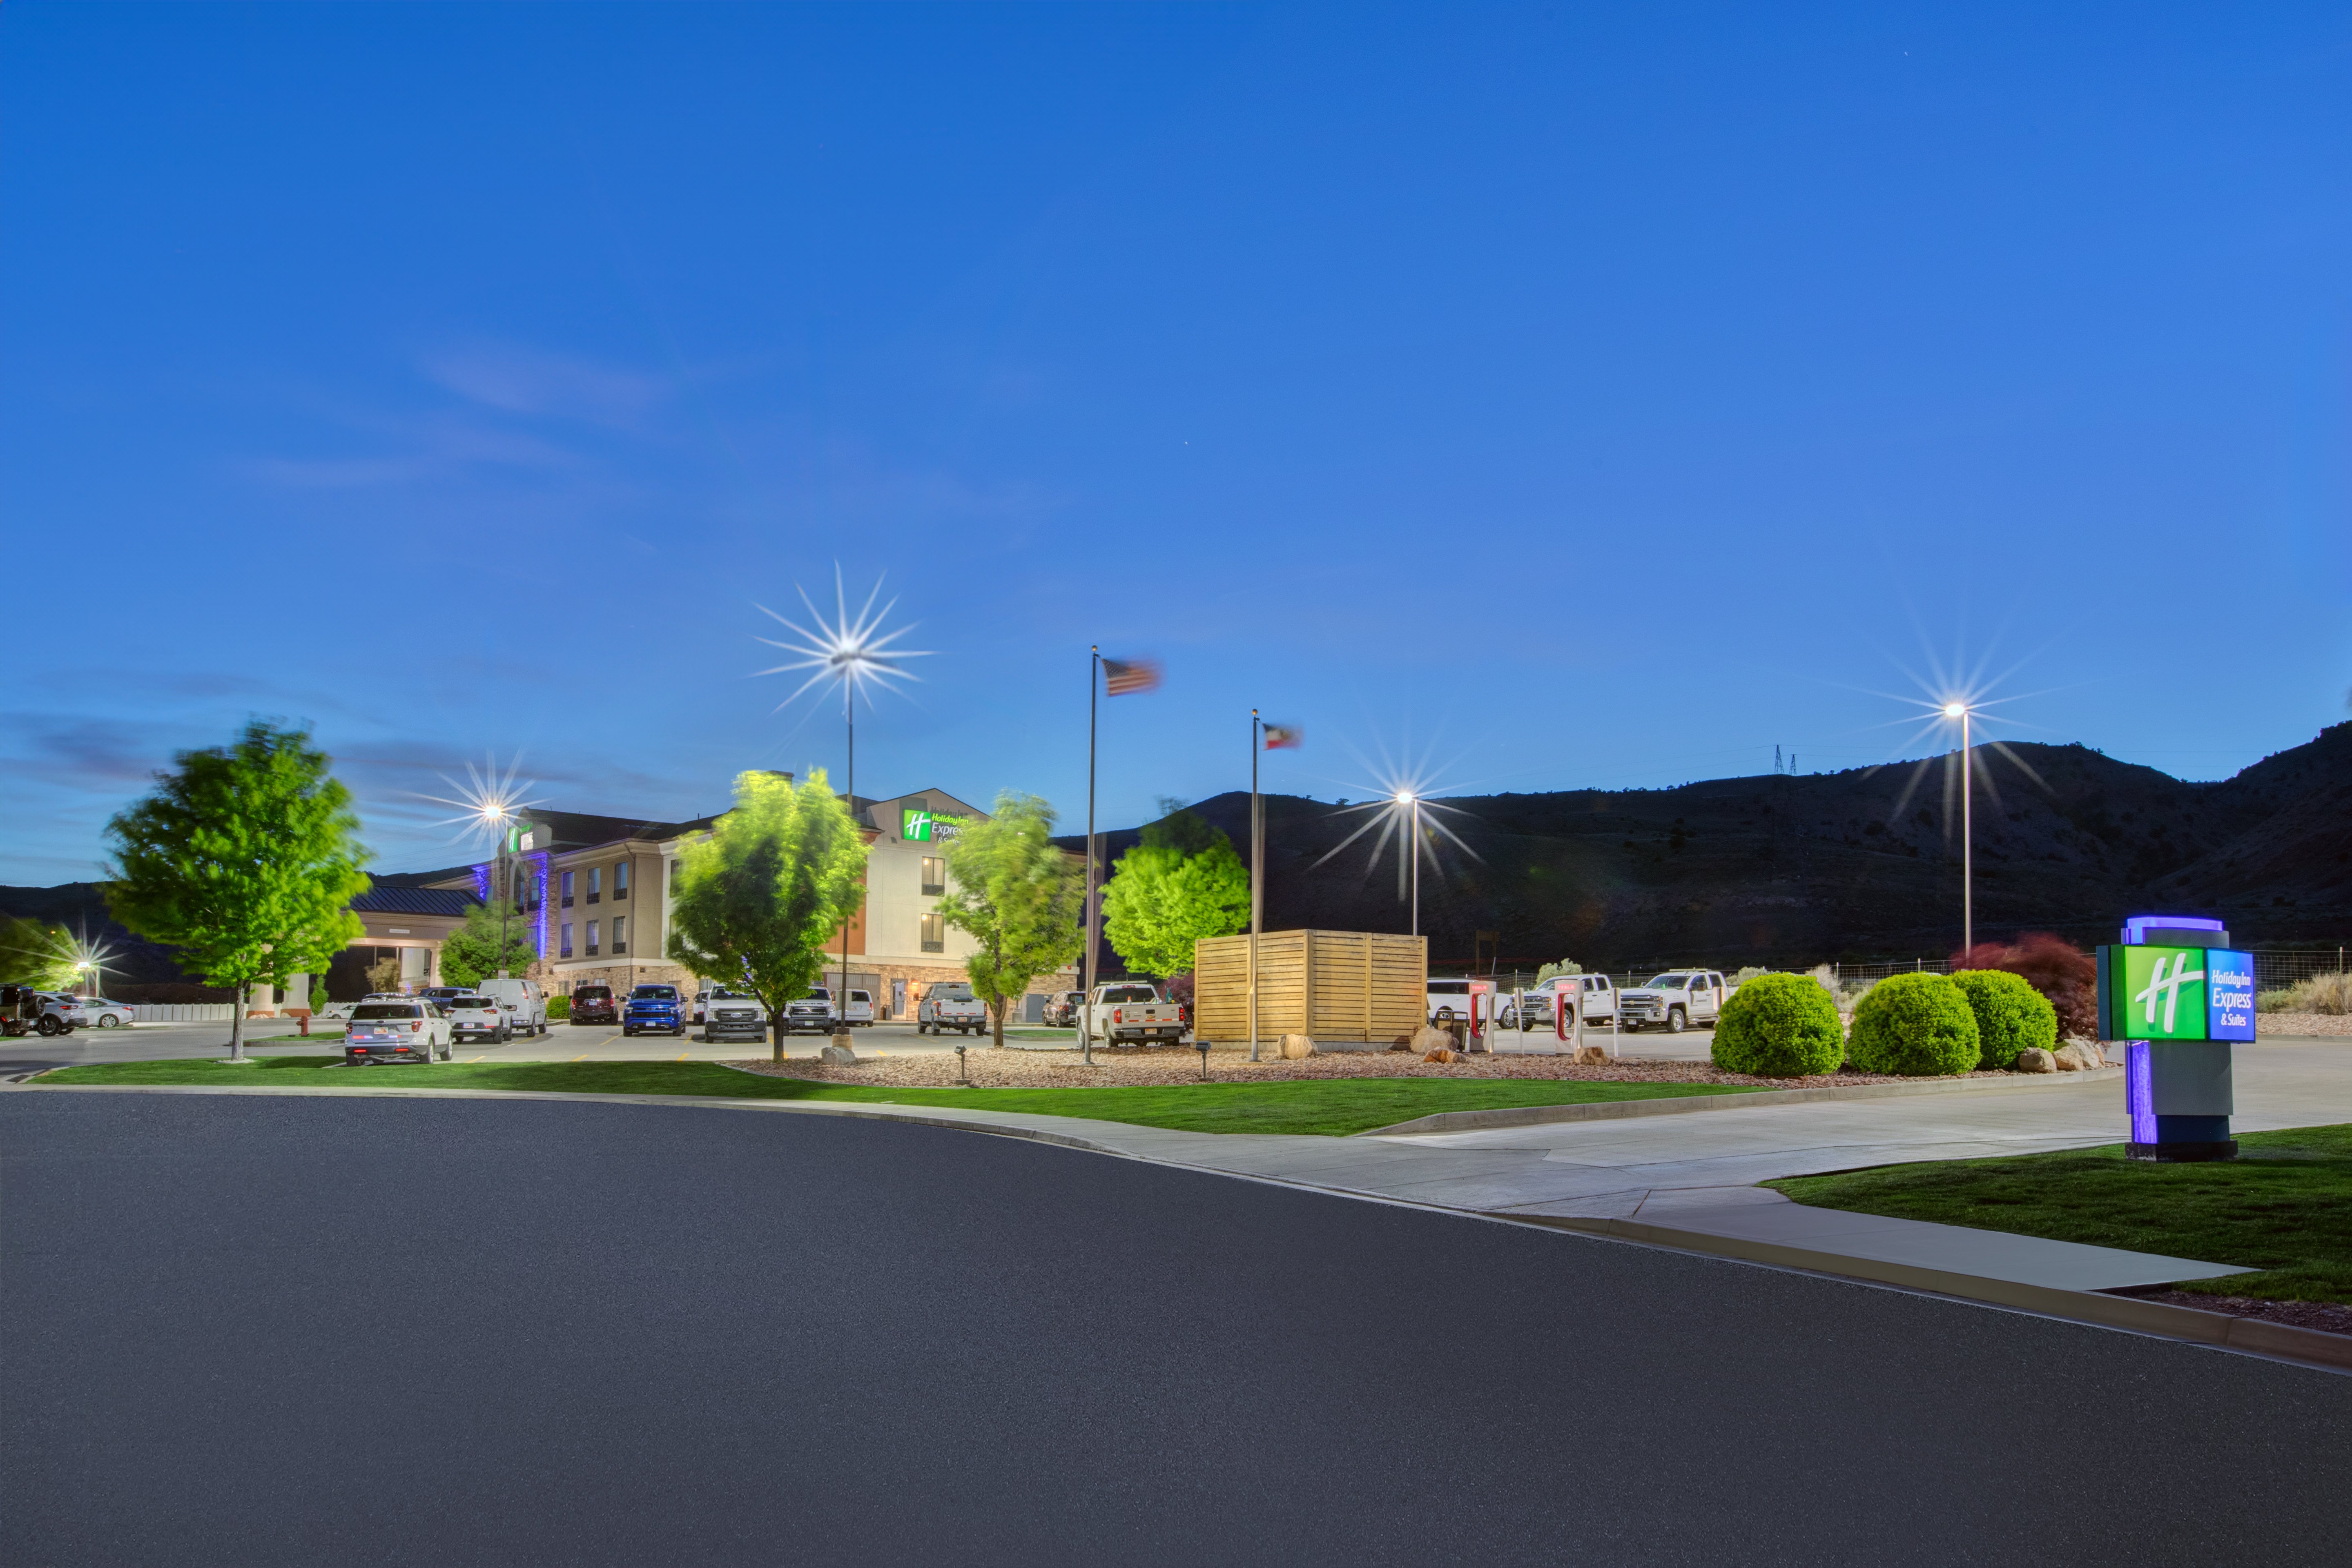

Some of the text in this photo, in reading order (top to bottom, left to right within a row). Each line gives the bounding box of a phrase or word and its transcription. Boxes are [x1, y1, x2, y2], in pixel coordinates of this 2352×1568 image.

[932, 822, 964, 836] Expres
[2212, 987, 2252, 1012] Express
[2220, 1013, 2246, 1026] & Suites
